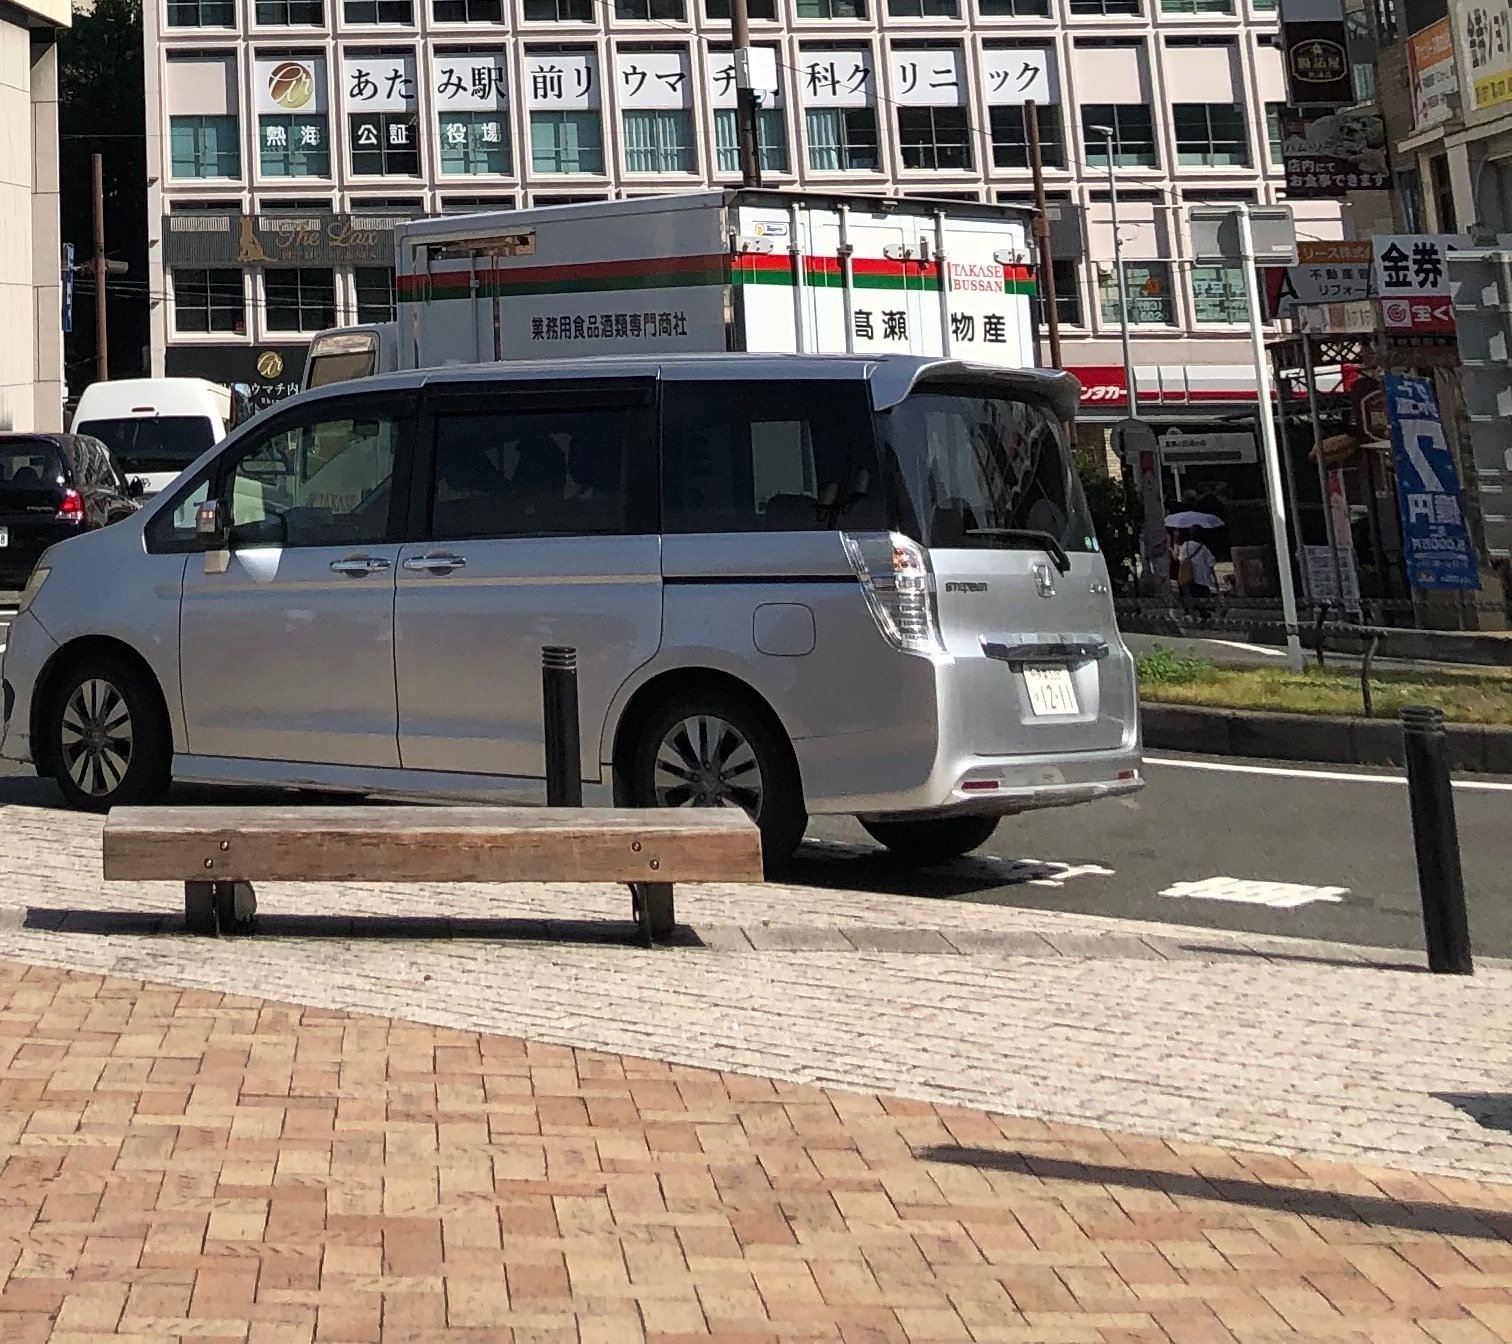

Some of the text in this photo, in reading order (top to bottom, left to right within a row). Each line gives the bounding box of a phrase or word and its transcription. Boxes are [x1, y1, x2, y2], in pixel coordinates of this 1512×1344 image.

[266, 122, 502, 149] 熱海公証役場
[951, 262, 1003, 279] TAKASE
[1380, 241, 1443, 289] 金券
[953, 278, 1004, 293] BUSSAN
[531, 311, 688, 341] 業務用食品酒類専門商社
